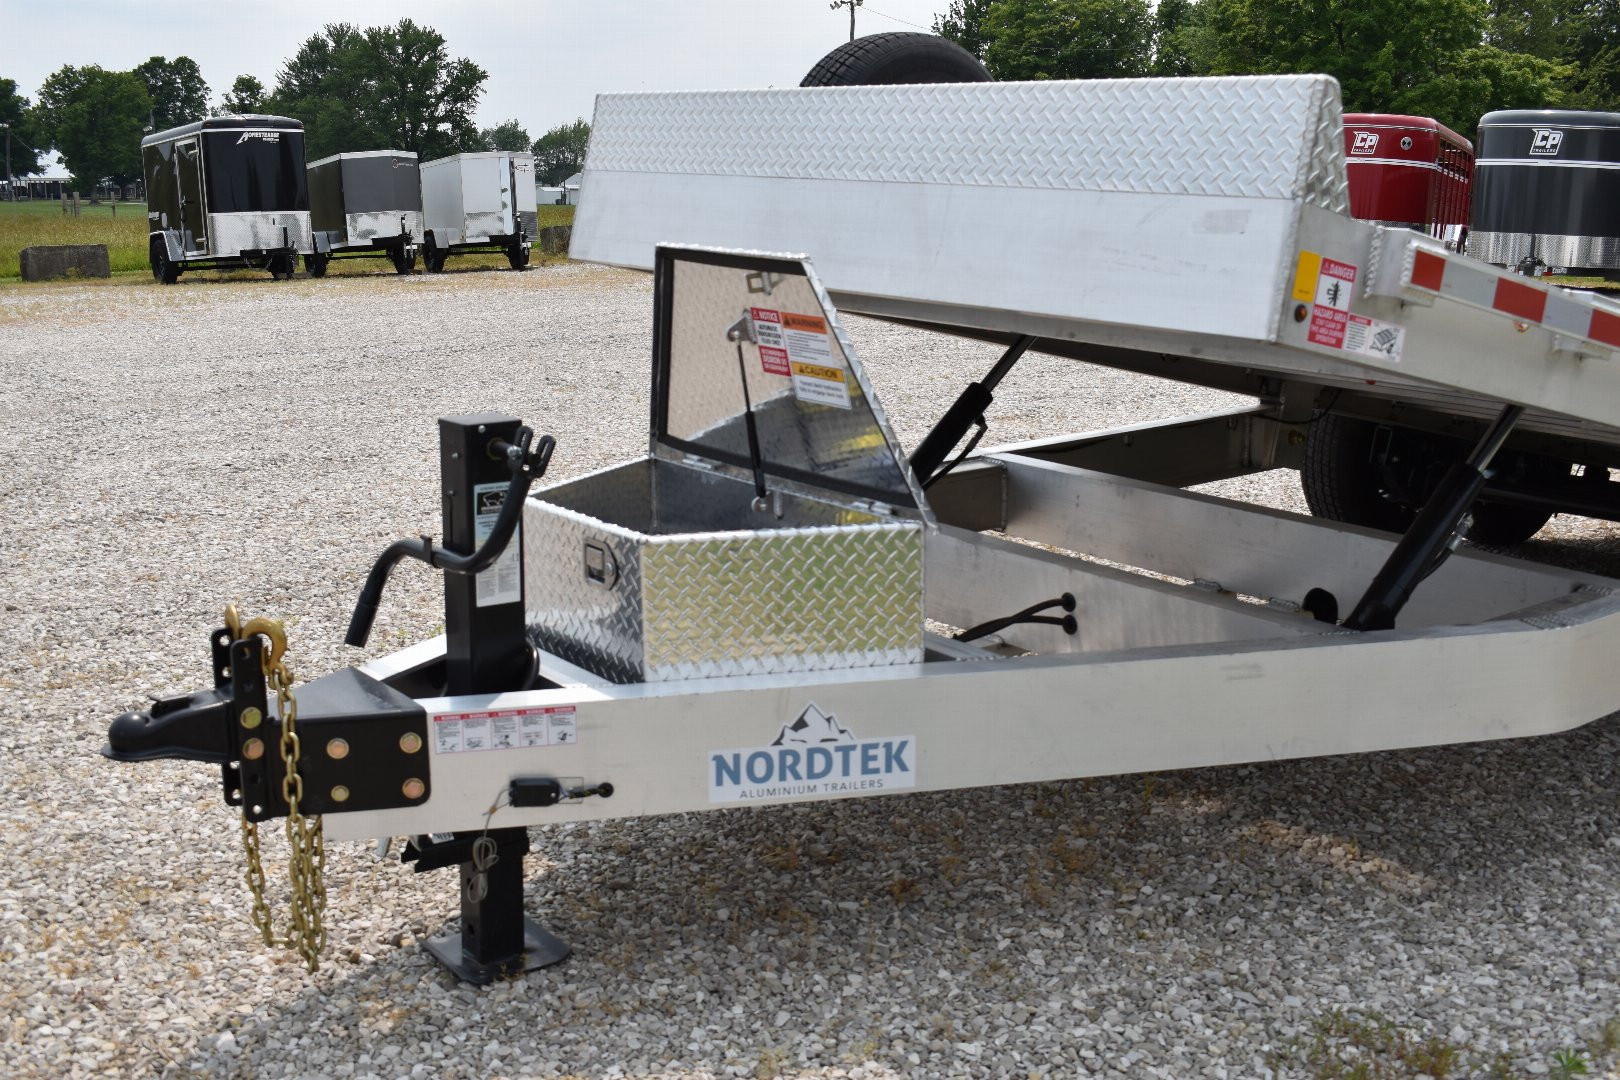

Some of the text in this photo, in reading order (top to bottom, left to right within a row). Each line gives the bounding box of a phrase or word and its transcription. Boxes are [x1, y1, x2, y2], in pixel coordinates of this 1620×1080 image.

[1355, 133, 1376, 149] CP
[1535, 130, 1561, 148] CP
[1329, 264, 1355, 280] DANGER
[760, 311, 778, 322] NOTICE
[790, 317, 823, 330] WARNING
[805, 365, 838, 379] CAUTION
[711, 740, 910, 787] NORDTEK
[738, 779, 884, 799] ALUMINIUM TRAILERS
